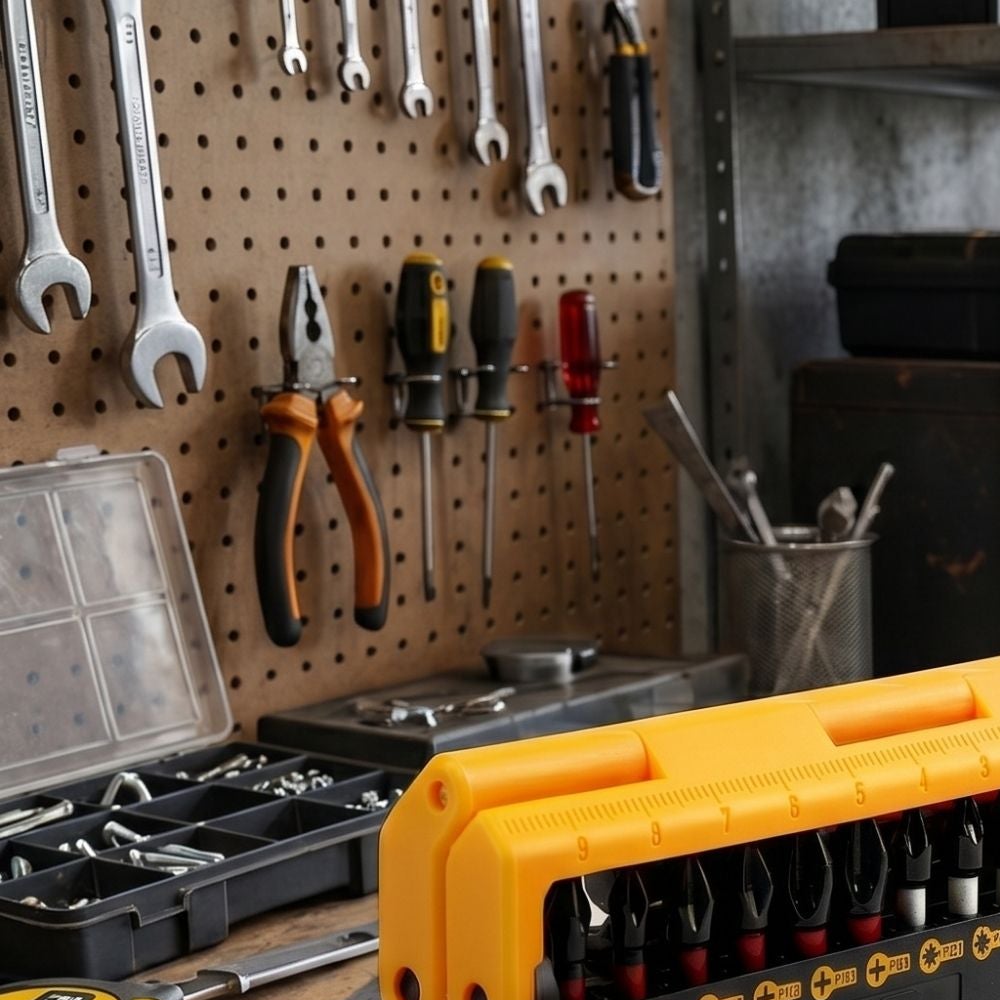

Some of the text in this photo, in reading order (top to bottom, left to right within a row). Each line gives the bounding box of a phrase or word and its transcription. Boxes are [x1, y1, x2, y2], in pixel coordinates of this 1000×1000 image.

[577, 836, 589, 861] 9
[651, 822, 662, 846] 8
[719, 806, 731, 834] 7
[788, 795, 800, 819] 6
[855, 782, 866, 805] 5
[919, 766, 929, 792] 4
[979, 755, 990, 778] 3
